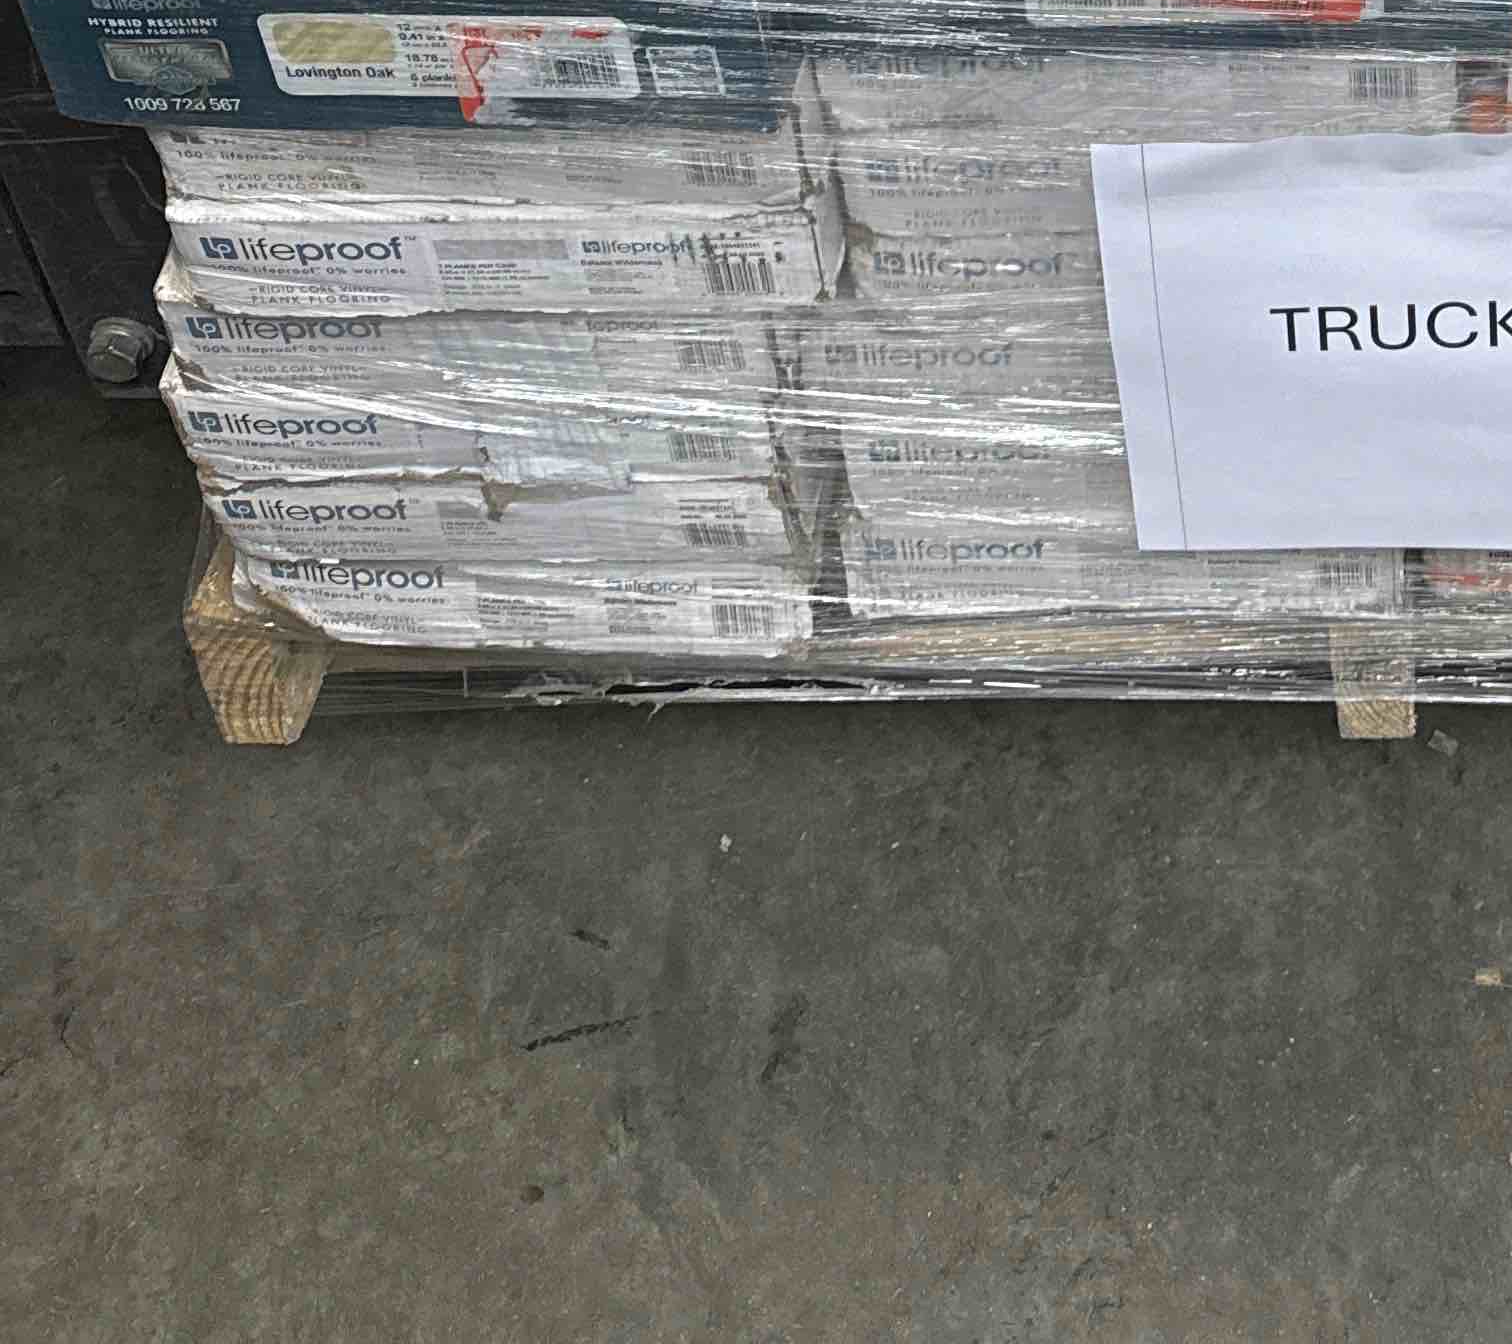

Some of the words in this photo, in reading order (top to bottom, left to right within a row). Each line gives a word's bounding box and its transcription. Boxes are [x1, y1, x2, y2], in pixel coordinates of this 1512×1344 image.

[87, 17, 143, 28] HYBRID
[285, 64, 363, 81] Lovington
[366, 65, 396, 80] Oak
[123, 97, 169, 112] 1009
[208, 98, 242, 112] 567
[242, 235, 402, 265] lifeproof
[224, 316, 384, 345] lifeproof
[862, 341, 1014, 370] lifeproof
[224, 412, 378, 439] lifeproof
[258, 498, 408, 525] lifeproof
[901, 538, 1046, 566] lifeproof
[304, 564, 446, 592] lifeproof
